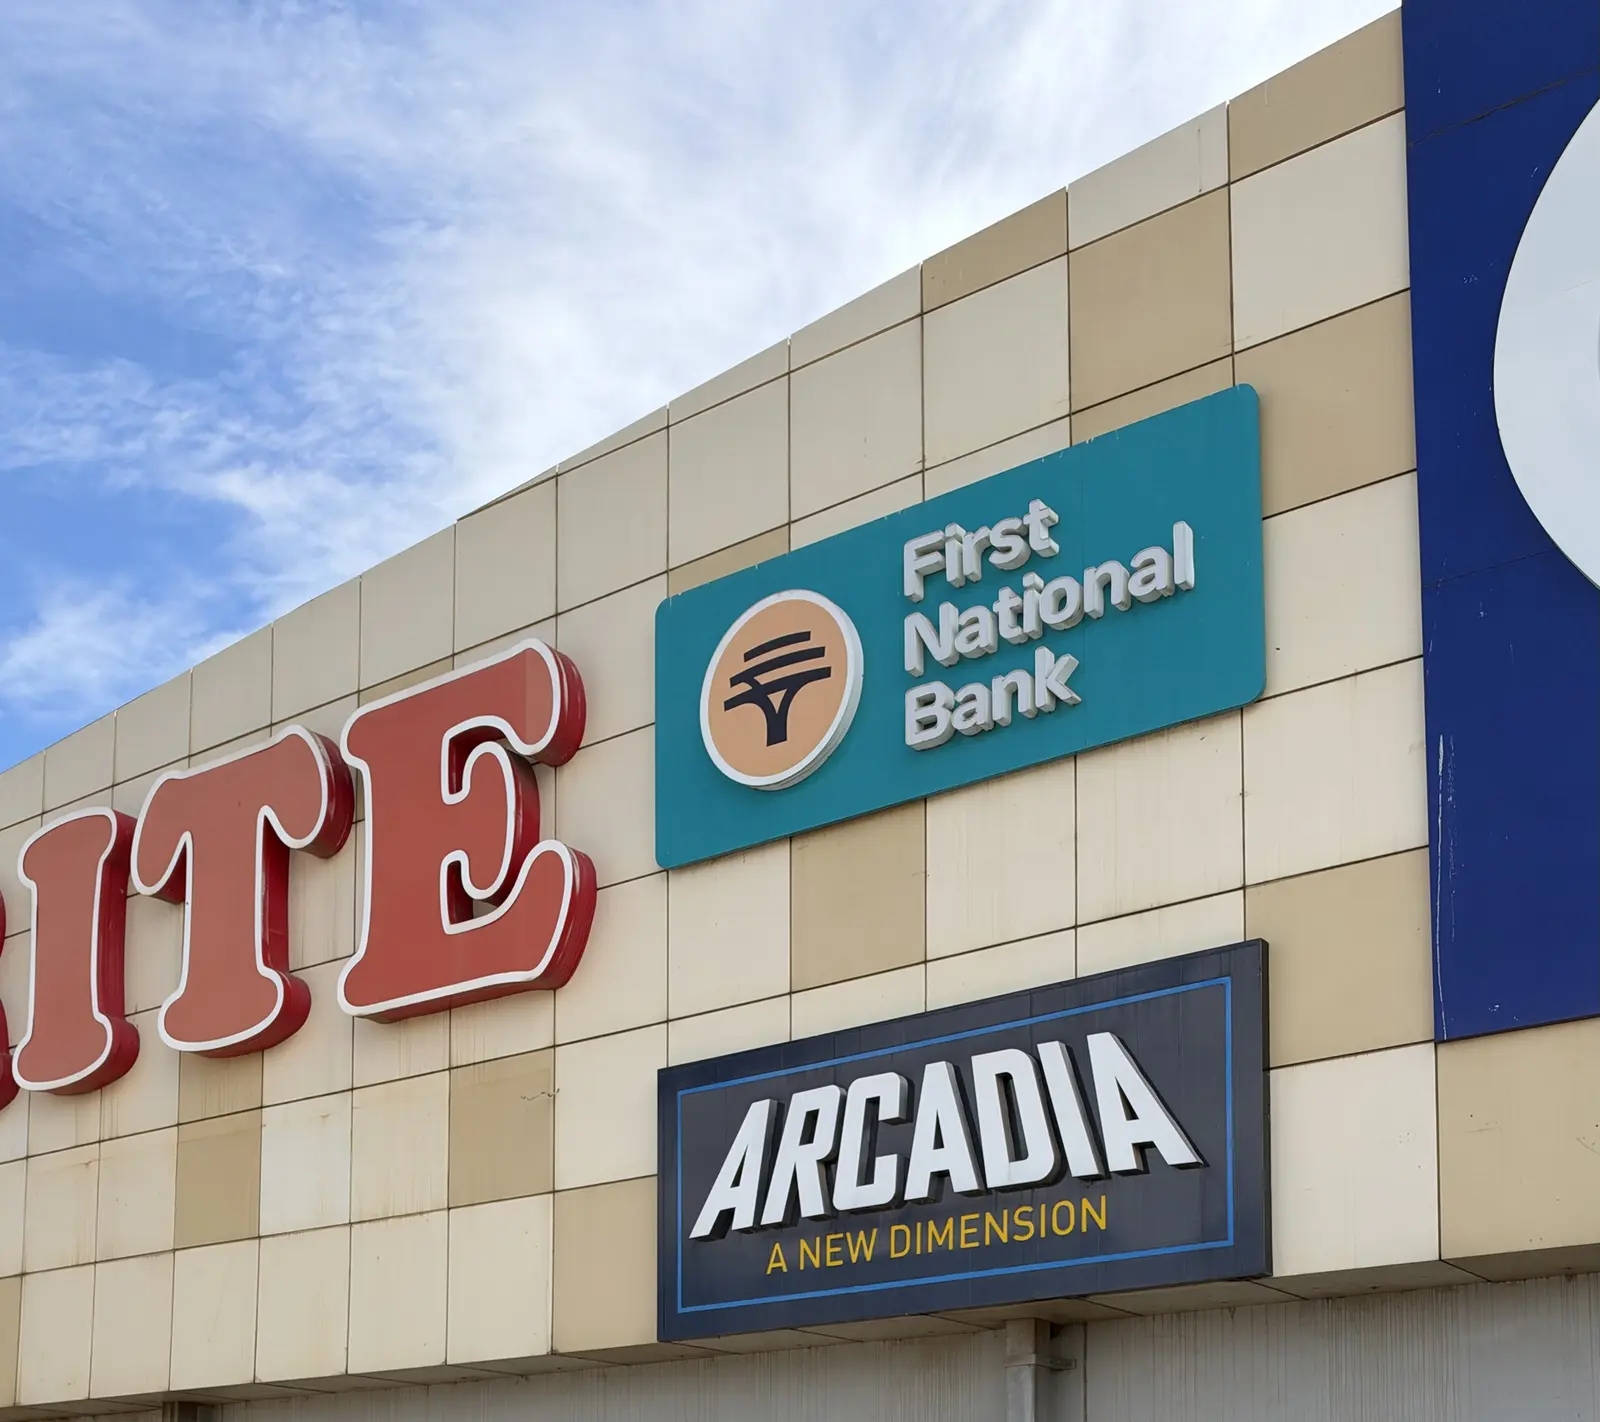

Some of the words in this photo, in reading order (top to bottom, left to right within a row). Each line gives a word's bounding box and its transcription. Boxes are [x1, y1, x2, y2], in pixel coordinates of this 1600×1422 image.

[903, 499, 1060, 602] First
[903, 521, 1195, 677] National
[904, 646, 1081, 751] Bank
[0, 638, 597, 1112] ITE
[689, 1031, 1203, 1241] ARCADIA
[766, 1242, 788, 1275] A
[799, 1227, 878, 1271] NEW
[889, 1195, 1108, 1259] DIMENSION
